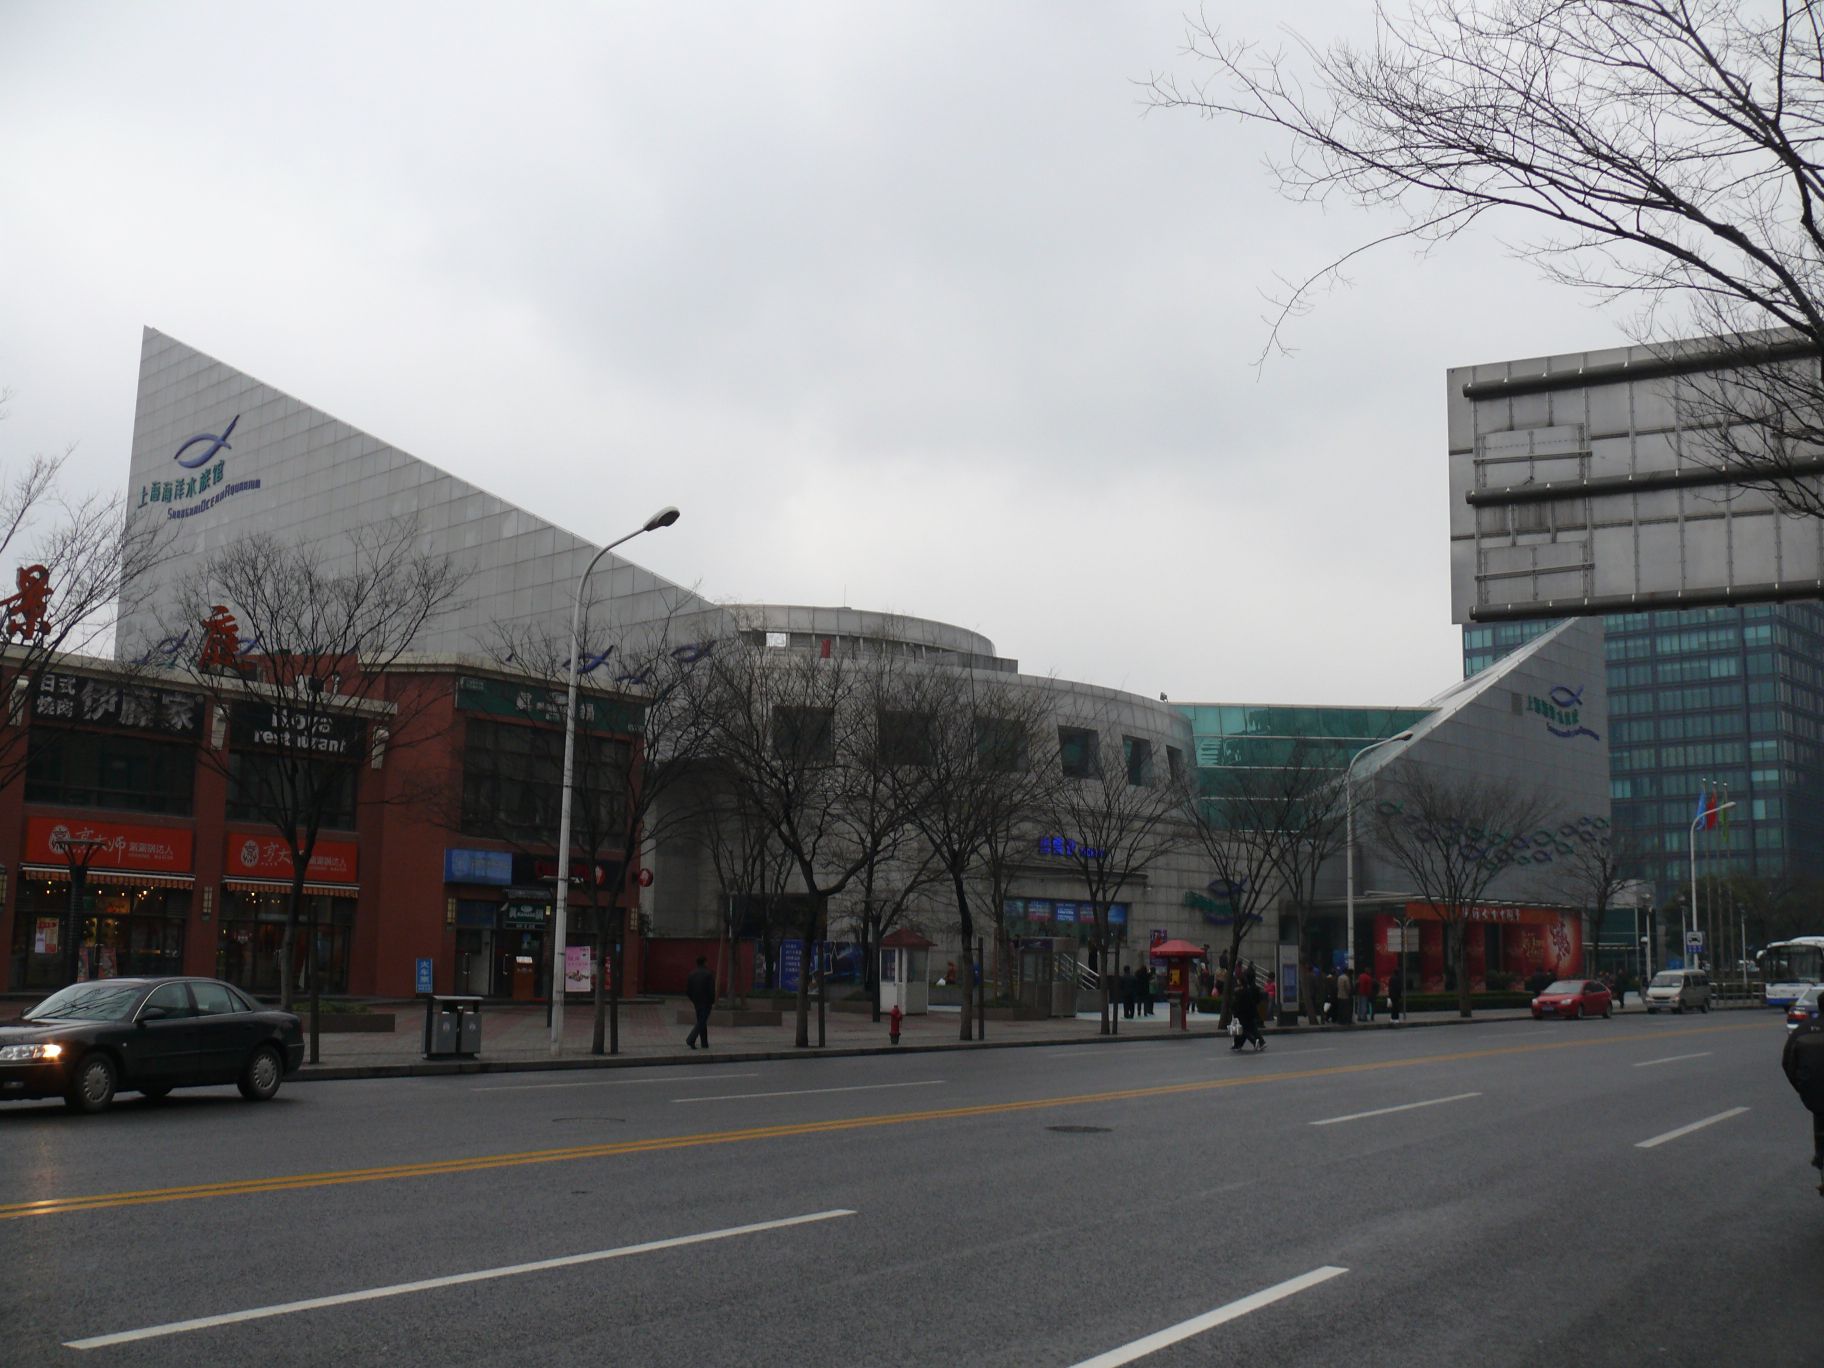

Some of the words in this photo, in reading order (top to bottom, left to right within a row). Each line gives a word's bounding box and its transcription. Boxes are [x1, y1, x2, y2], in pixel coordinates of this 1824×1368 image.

[137, 459, 225, 509] 上海海洋水族馆
[40, 674, 76, 695] 日式
